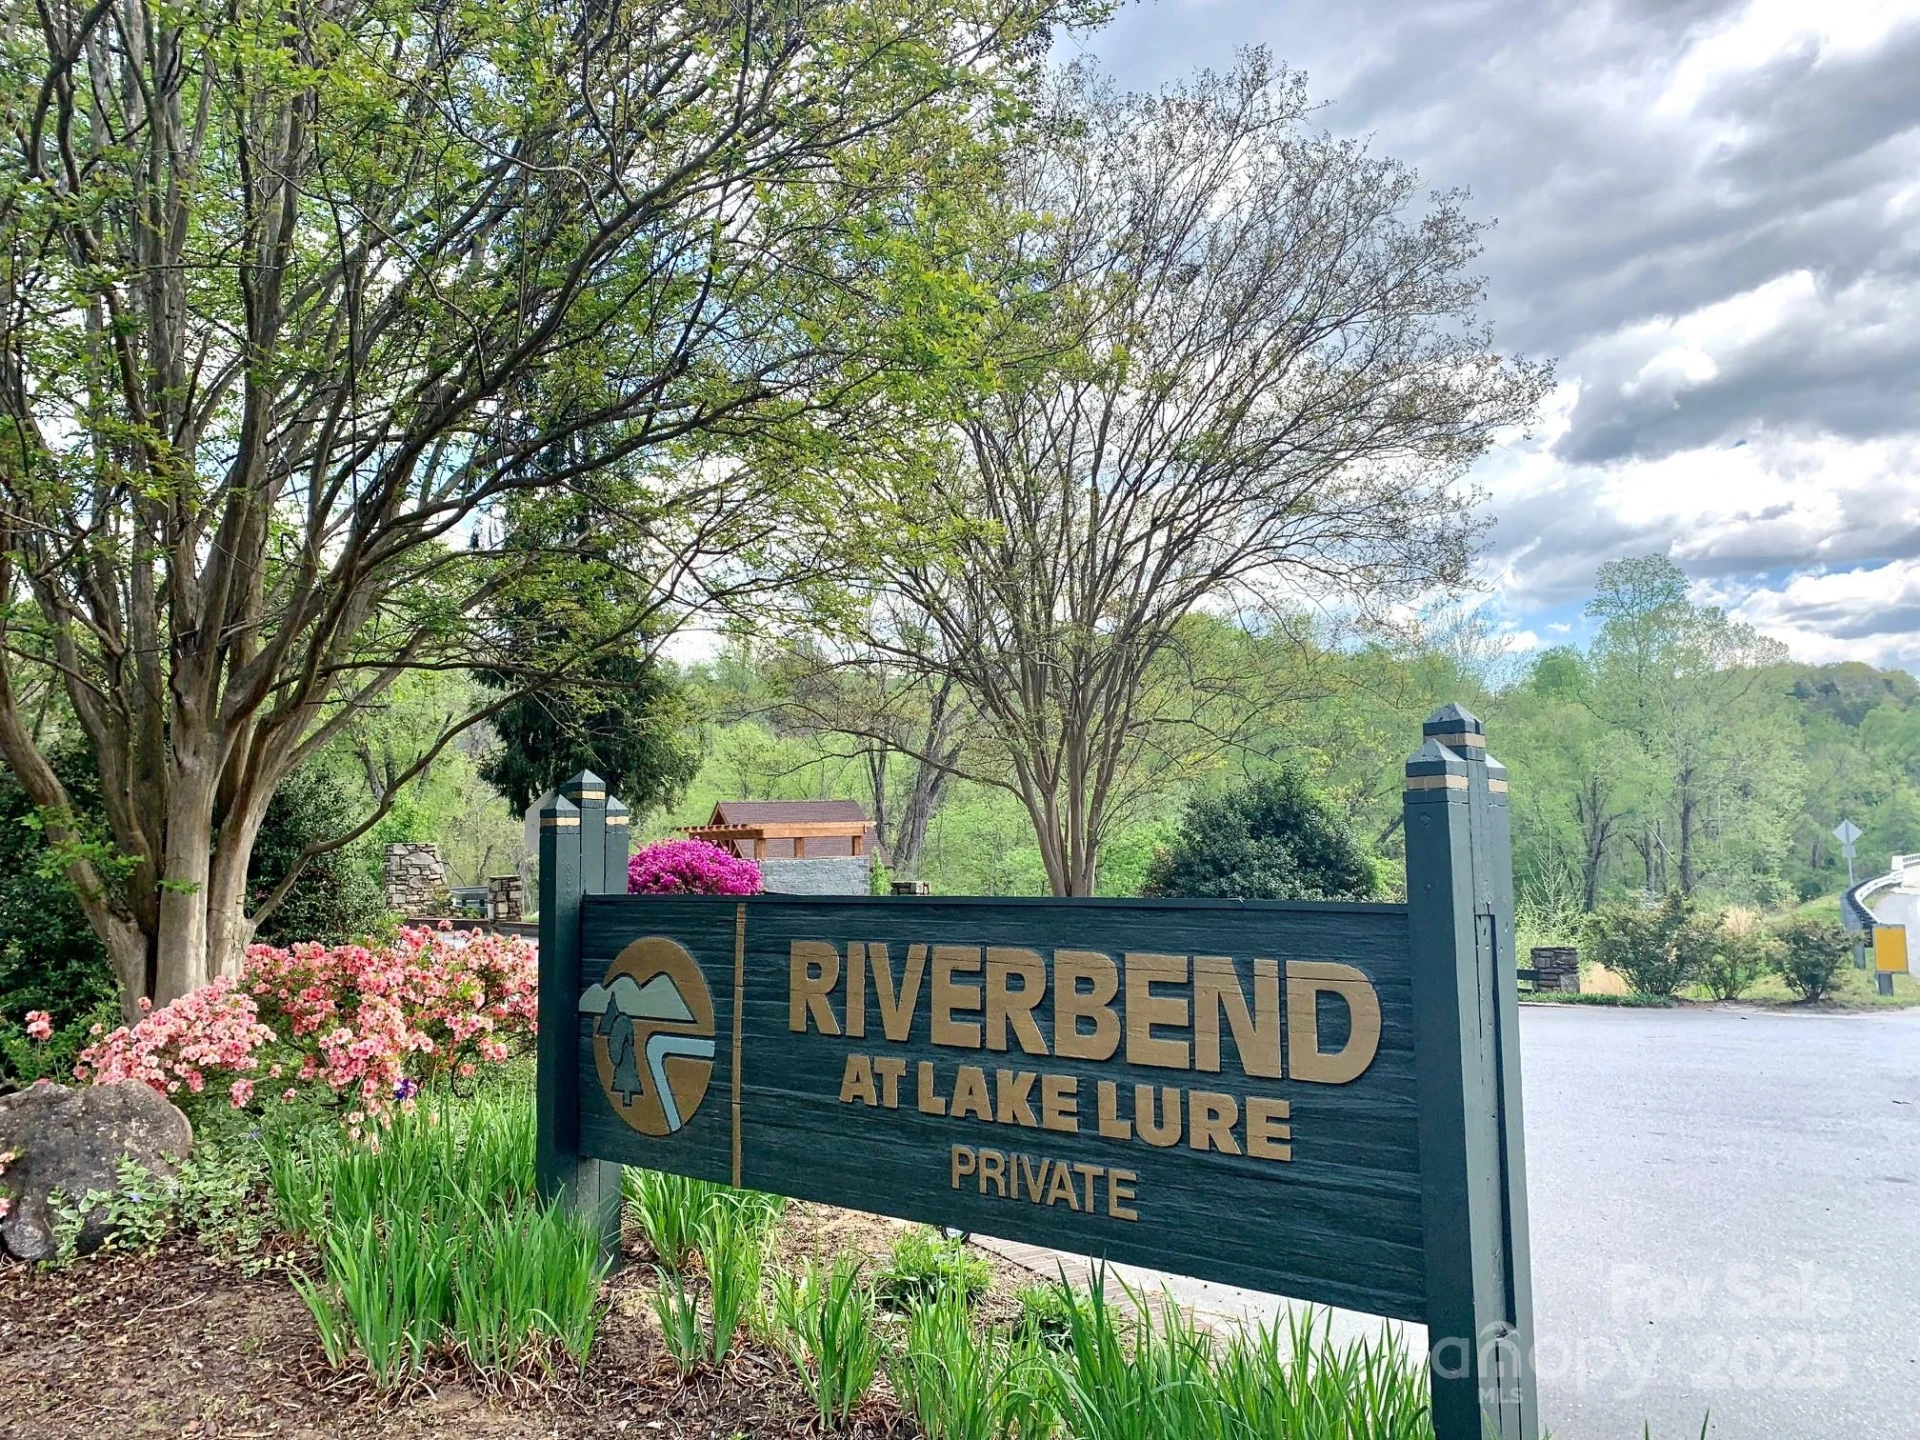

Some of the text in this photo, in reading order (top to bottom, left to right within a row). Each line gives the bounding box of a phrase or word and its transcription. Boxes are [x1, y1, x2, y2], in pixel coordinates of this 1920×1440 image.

[789, 939, 1382, 1085] RIVERBEND
[839, 1054, 1293, 1163] AT LAKE LURE
[950, 1145, 1140, 1223] PRIVATE
